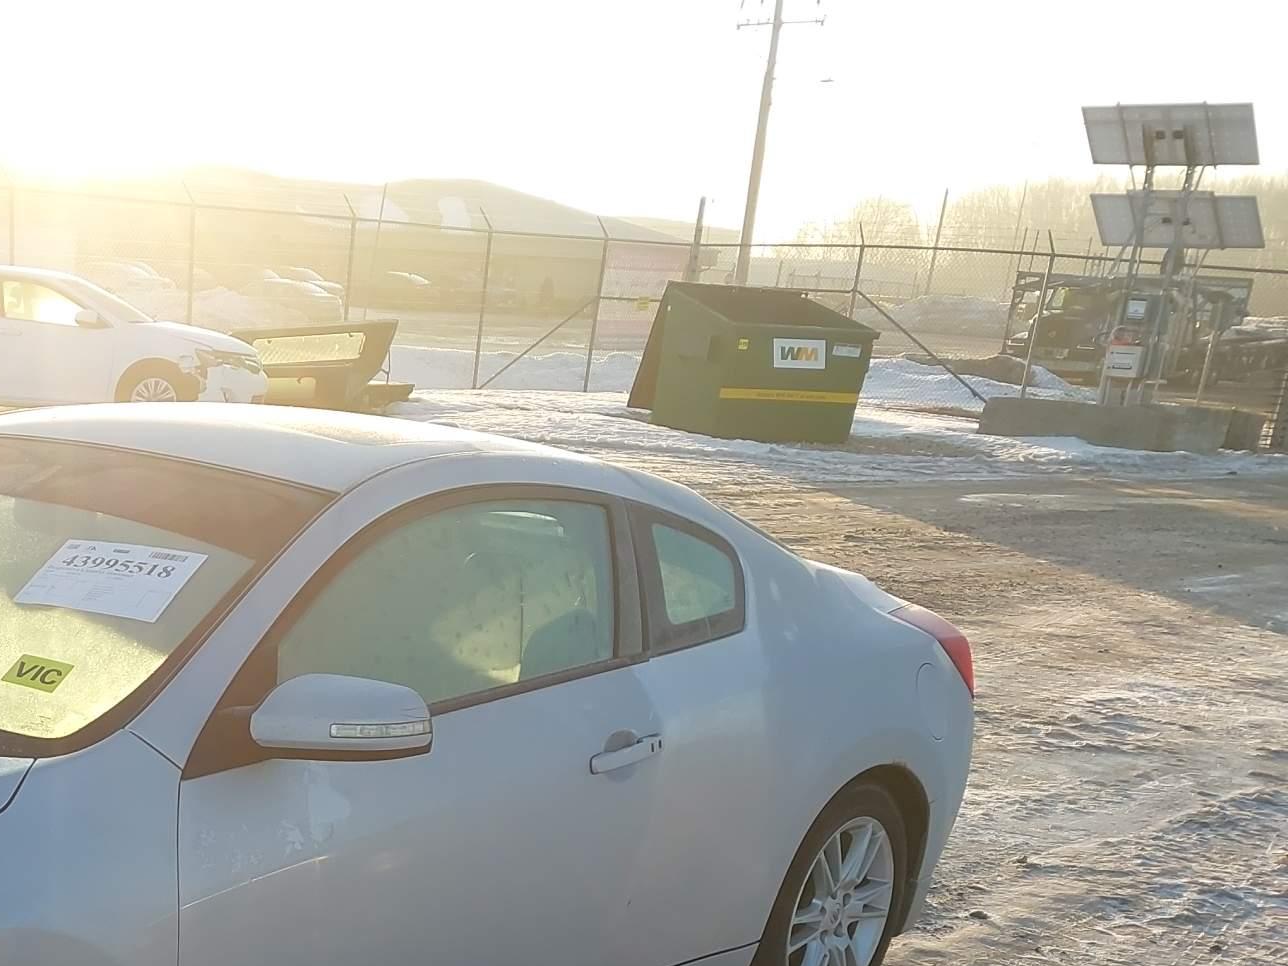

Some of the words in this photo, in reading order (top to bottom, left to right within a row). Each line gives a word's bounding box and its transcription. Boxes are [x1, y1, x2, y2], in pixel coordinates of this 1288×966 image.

[780, 346, 818, 360] WM
[62, 554, 176, 579] 43995518
[14, 660, 63, 686] VIC
